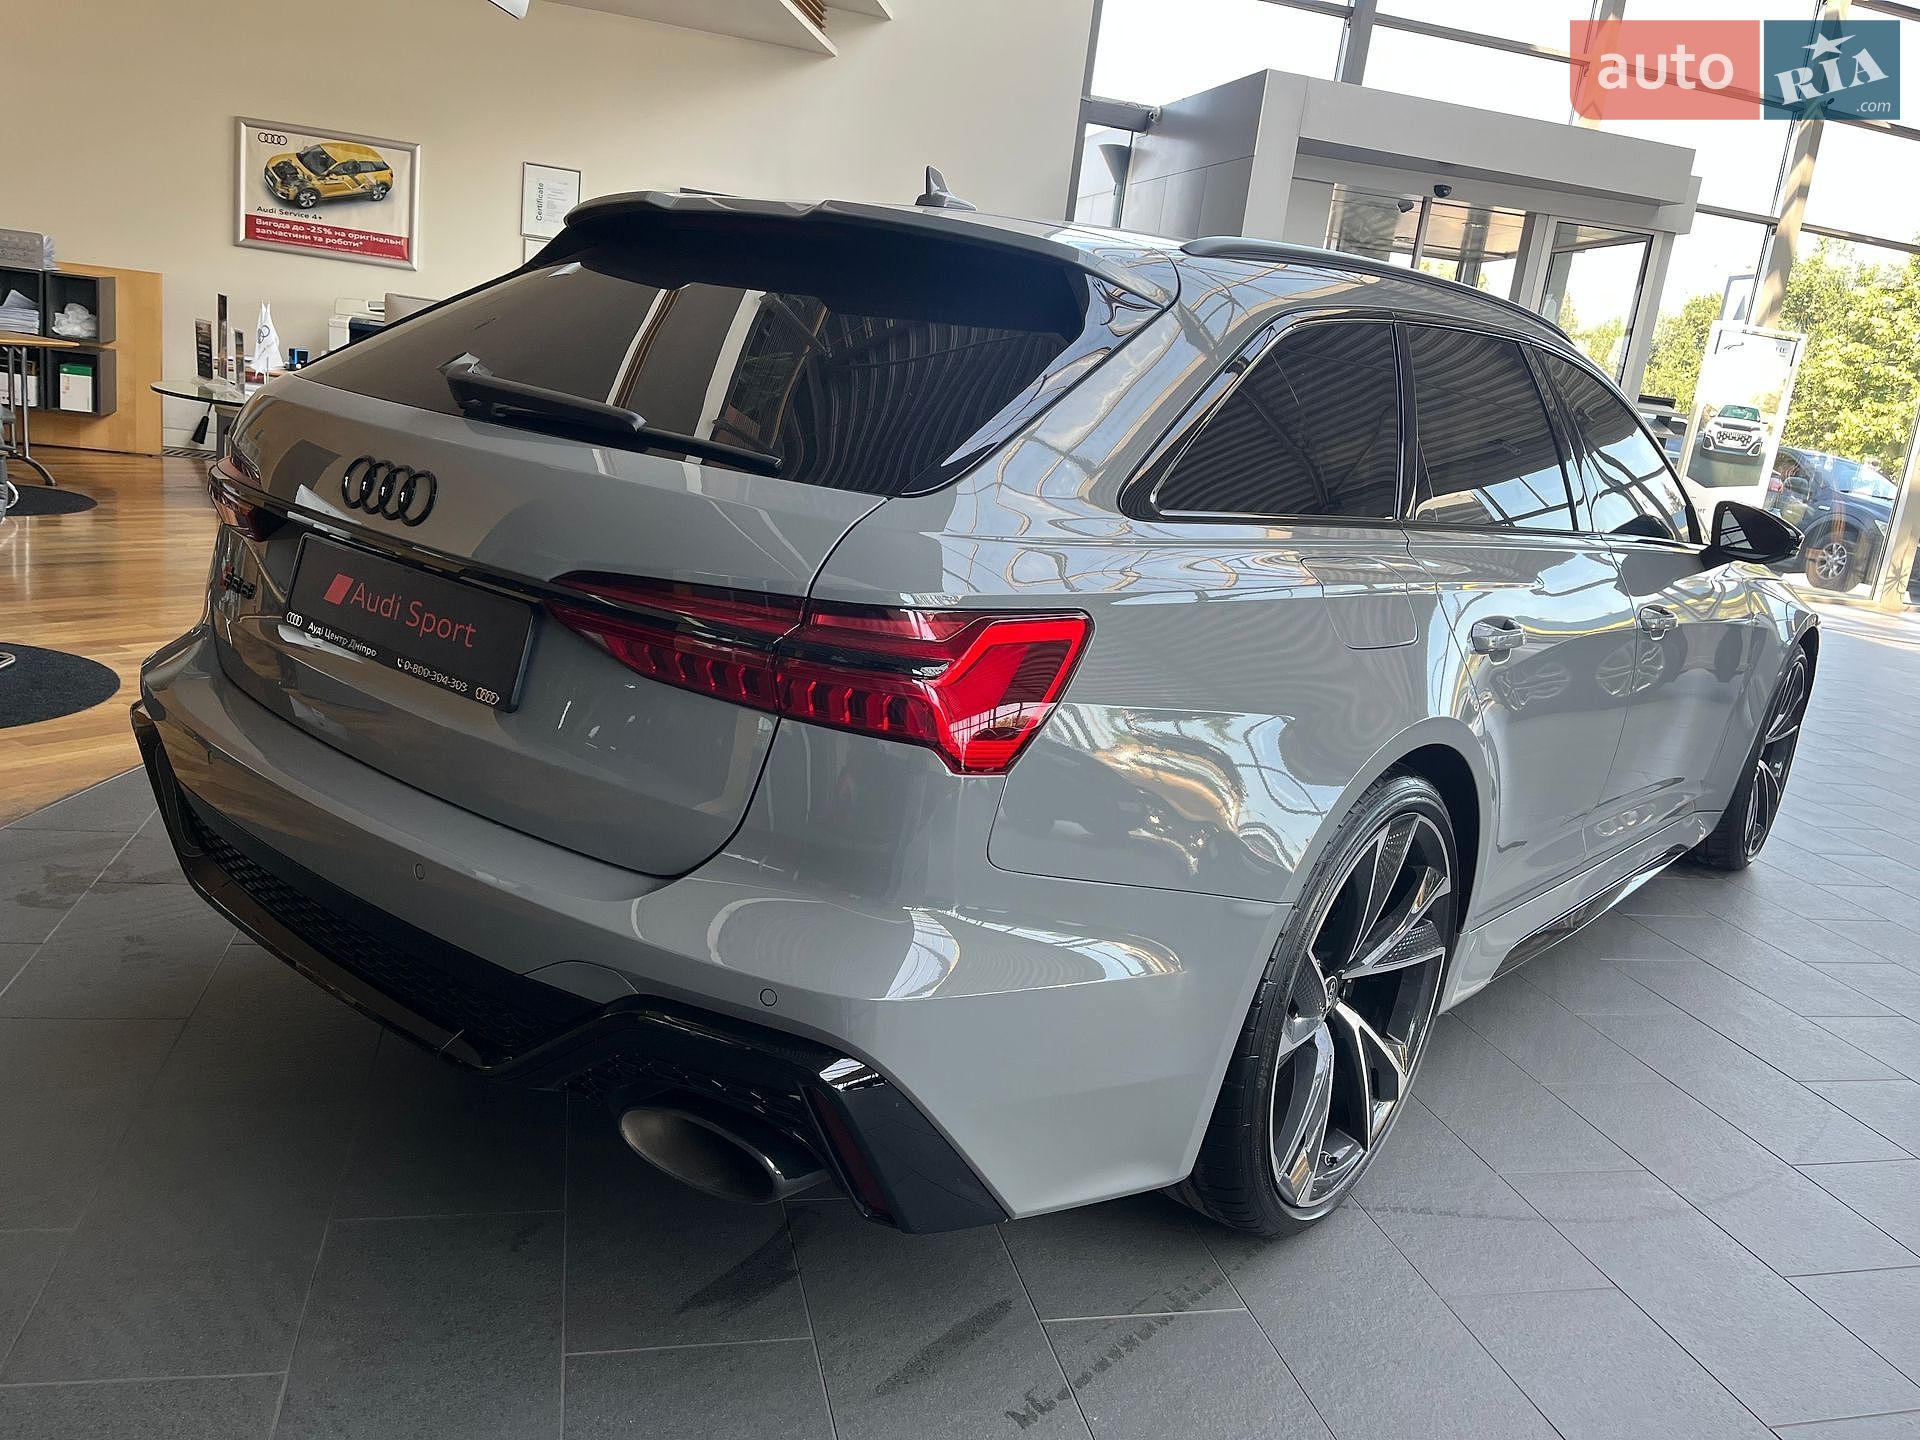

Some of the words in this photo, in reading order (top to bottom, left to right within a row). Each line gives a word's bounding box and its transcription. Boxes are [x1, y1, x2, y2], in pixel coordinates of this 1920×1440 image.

[256, 206, 277, 214] Audi
[279, 208, 310, 219] Service
[535, 182, 544, 221] Certificate
[255, 218, 291, 230] Вигода
[292, 224, 305, 232] до
[306, 225, 332, 235] -25%
[347, 233, 404, 246] оригінальні
[255, 227, 311, 240] запчастини
[350, 582, 402, 620] Audi
[405, 600, 477, 648] Sport
[307, 621, 325, 636] Ауді
[324, 628, 349, 647] Центр
[347, 638, 378, 657] Дніпро
[404, 660, 468, 692] 0-800-304-303
